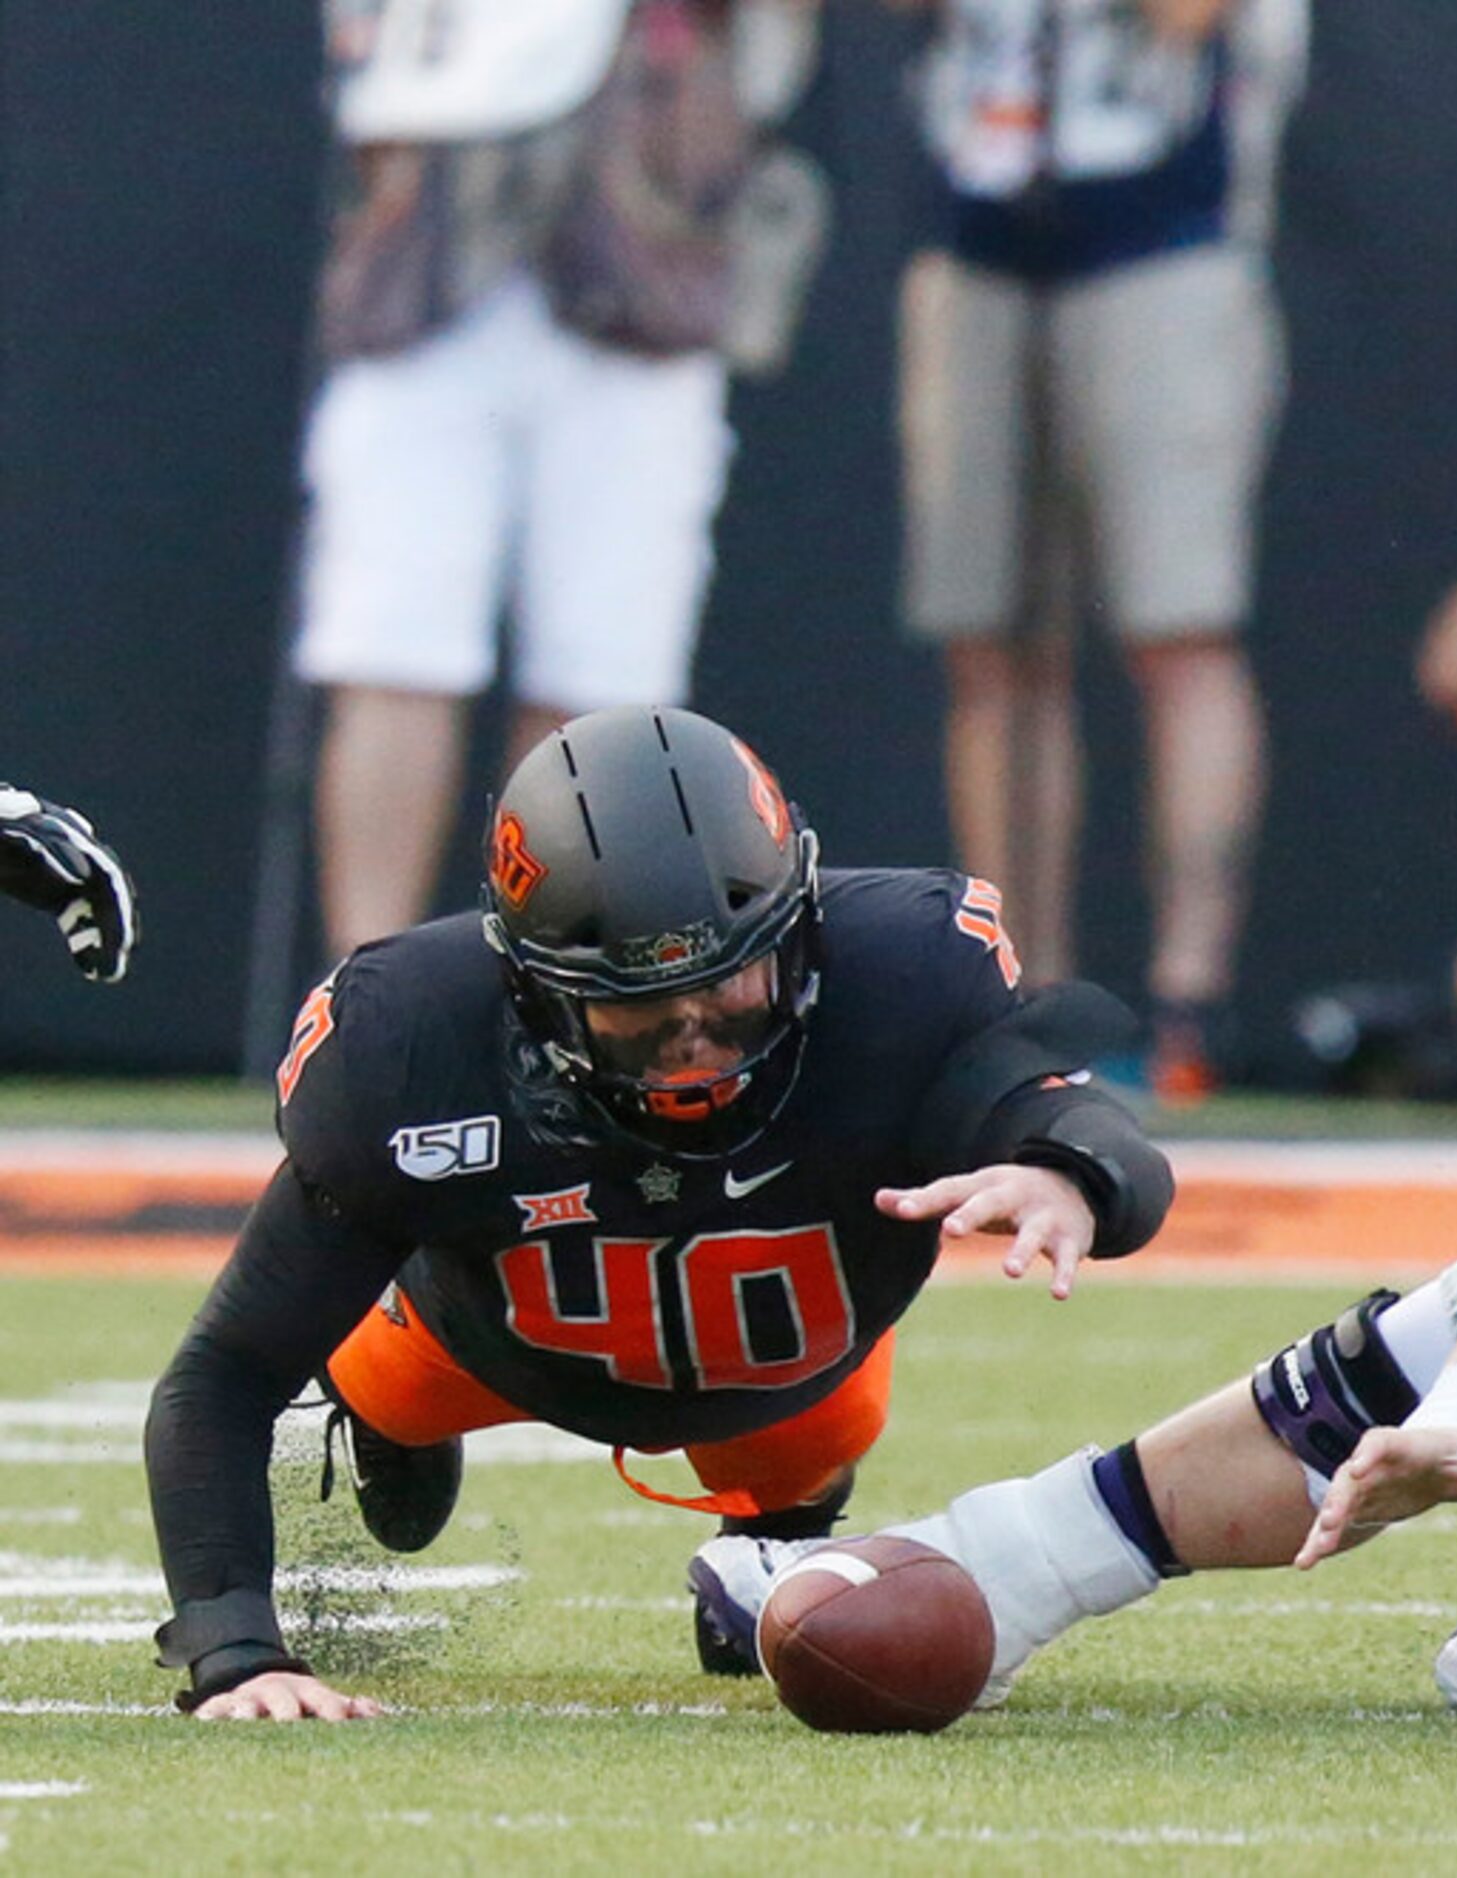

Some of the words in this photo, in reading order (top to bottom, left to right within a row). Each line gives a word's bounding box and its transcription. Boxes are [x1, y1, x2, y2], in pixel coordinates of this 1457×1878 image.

[390, 1116, 499, 1180] 150
[515, 1183, 597, 1232] XII
[494, 1222, 855, 1390] 40
